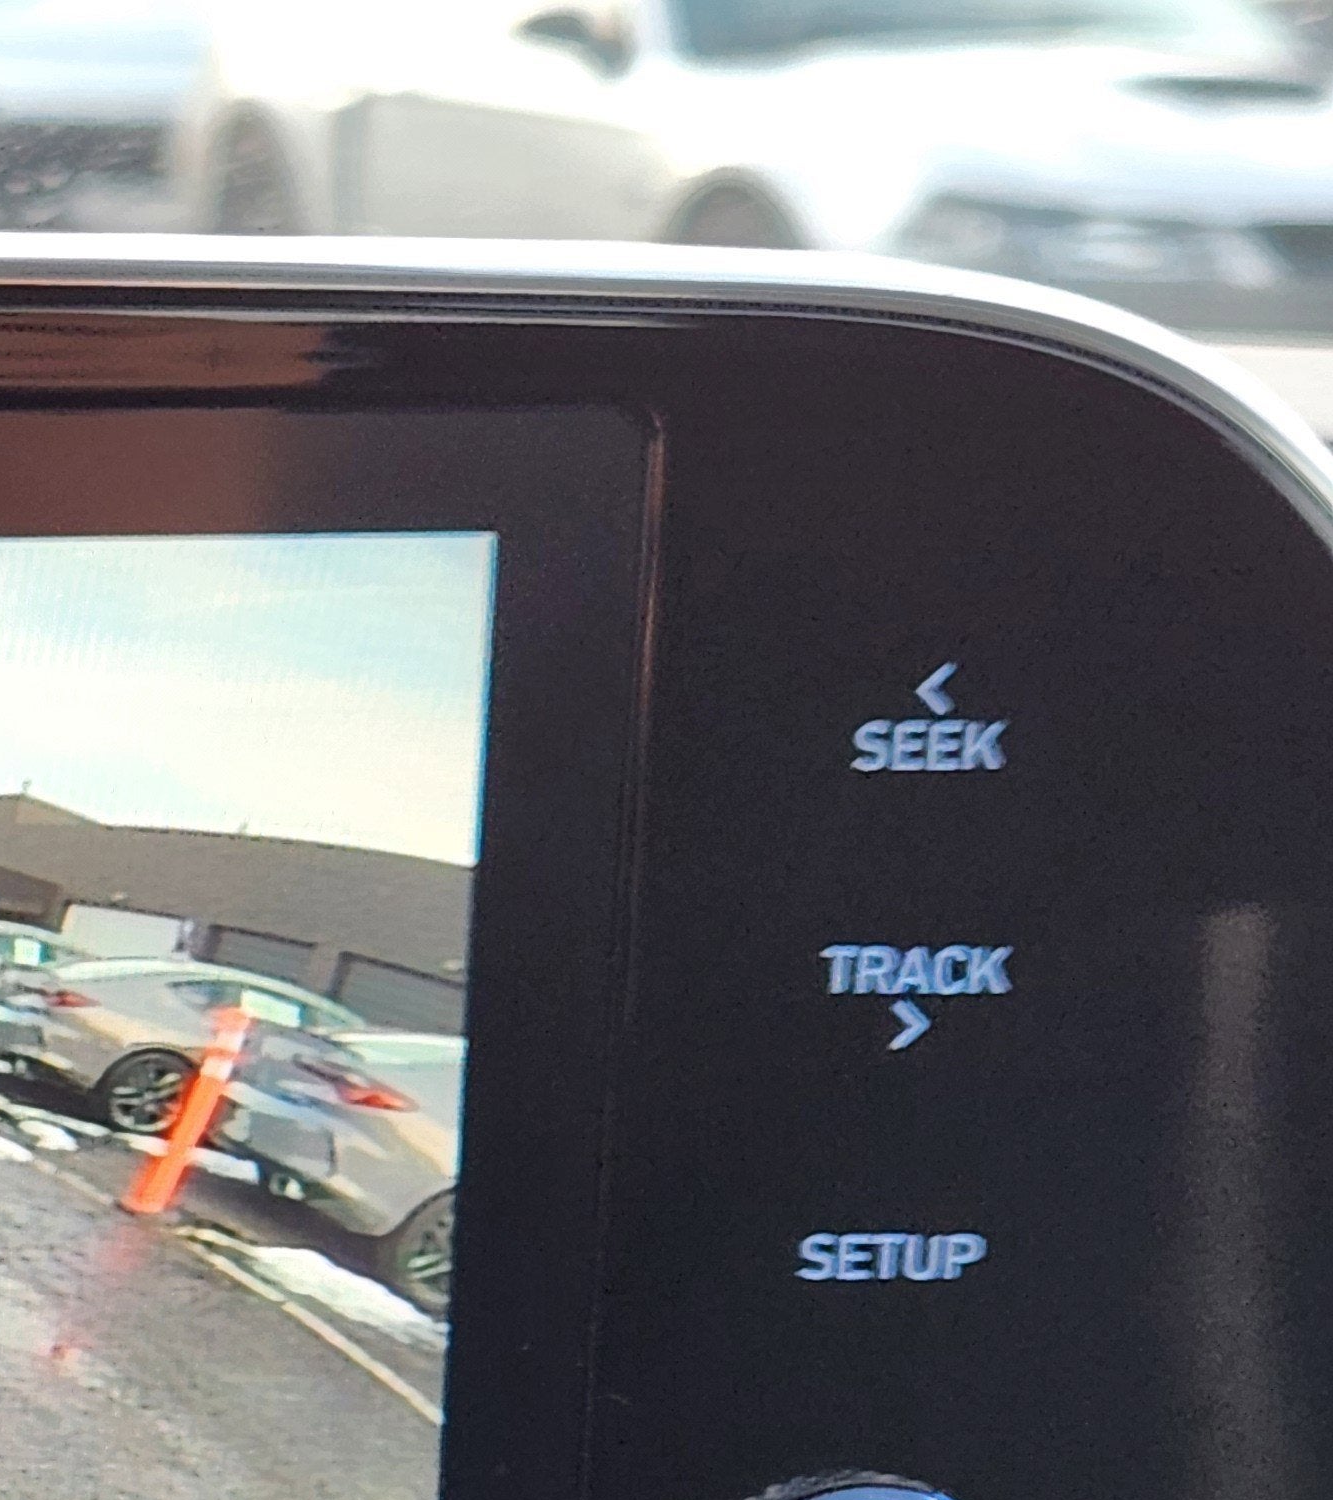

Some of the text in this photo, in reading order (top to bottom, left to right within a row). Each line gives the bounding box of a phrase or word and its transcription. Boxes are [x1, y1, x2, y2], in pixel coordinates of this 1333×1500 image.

[850, 719, 1009, 772] SEEK
[820, 946, 1013, 995] TRACK
[795, 1233, 987, 1281] SETUP
